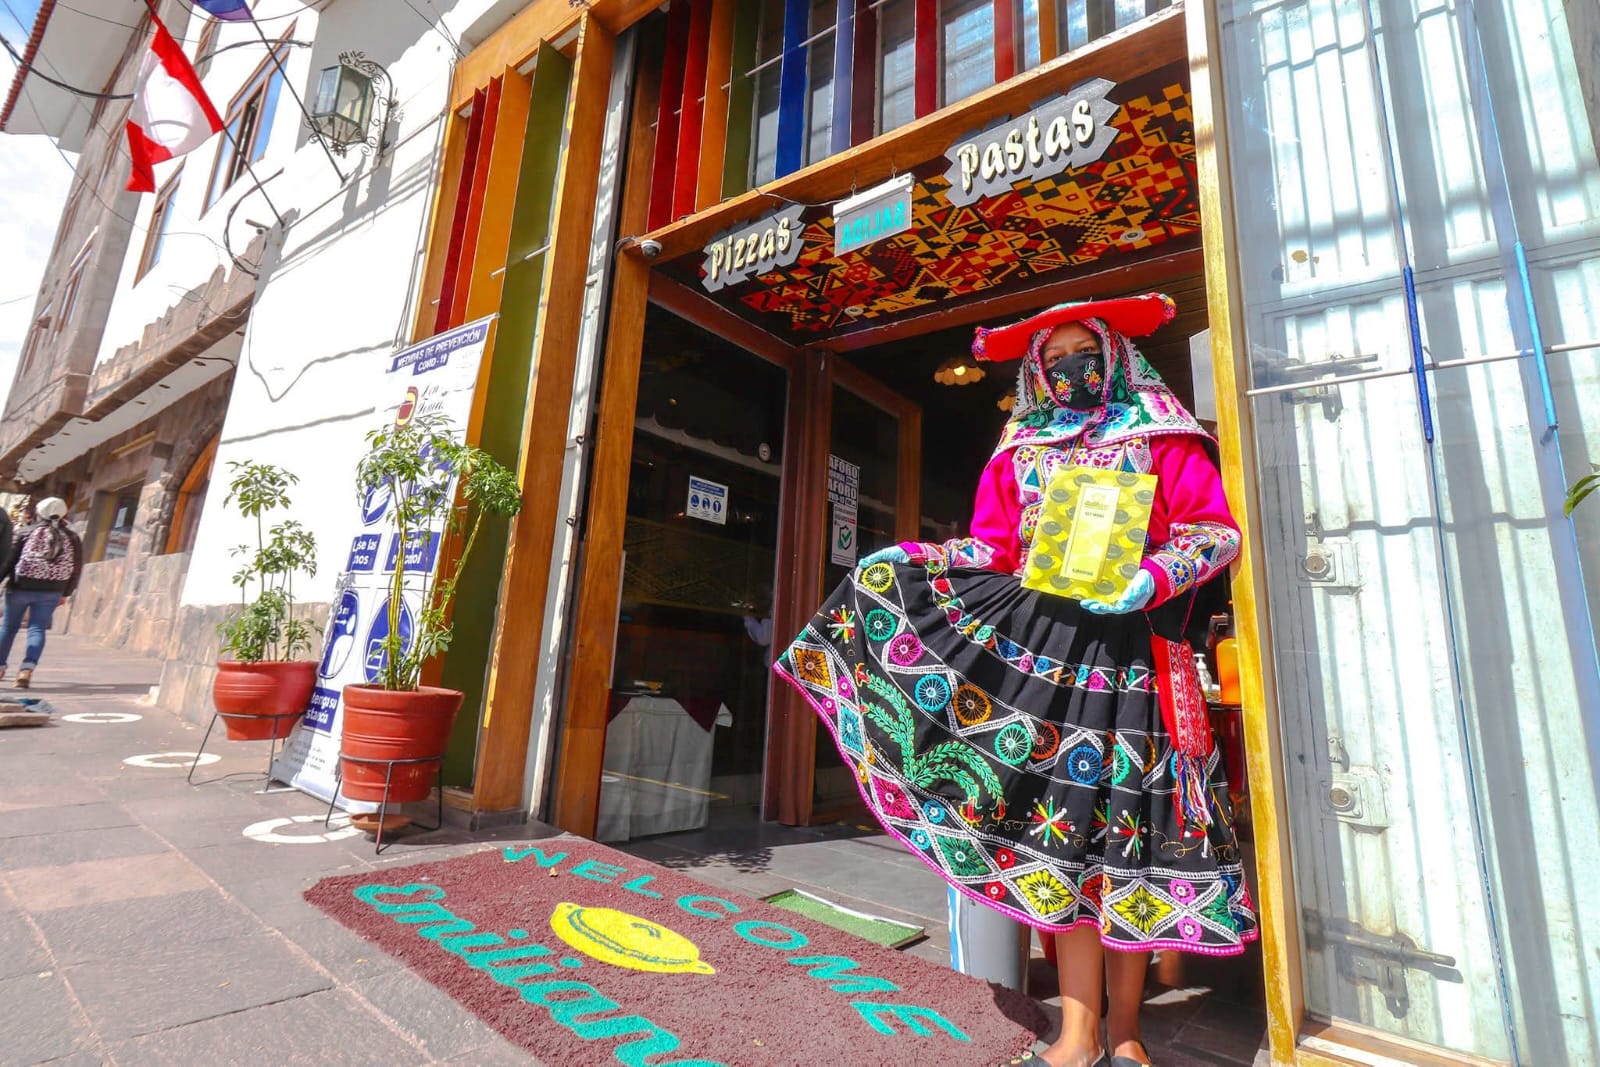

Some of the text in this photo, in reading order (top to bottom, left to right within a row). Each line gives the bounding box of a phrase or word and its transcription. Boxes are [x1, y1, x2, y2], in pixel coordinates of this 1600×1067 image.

[956, 99, 1094, 192] Pastas
[710, 216, 792, 281] Pizzas
[434, 328, 482, 353] PREVENCIÓN
[353, 883, 728, 1067] Emilian
[503, 846, 972, 1043] WELCOME
